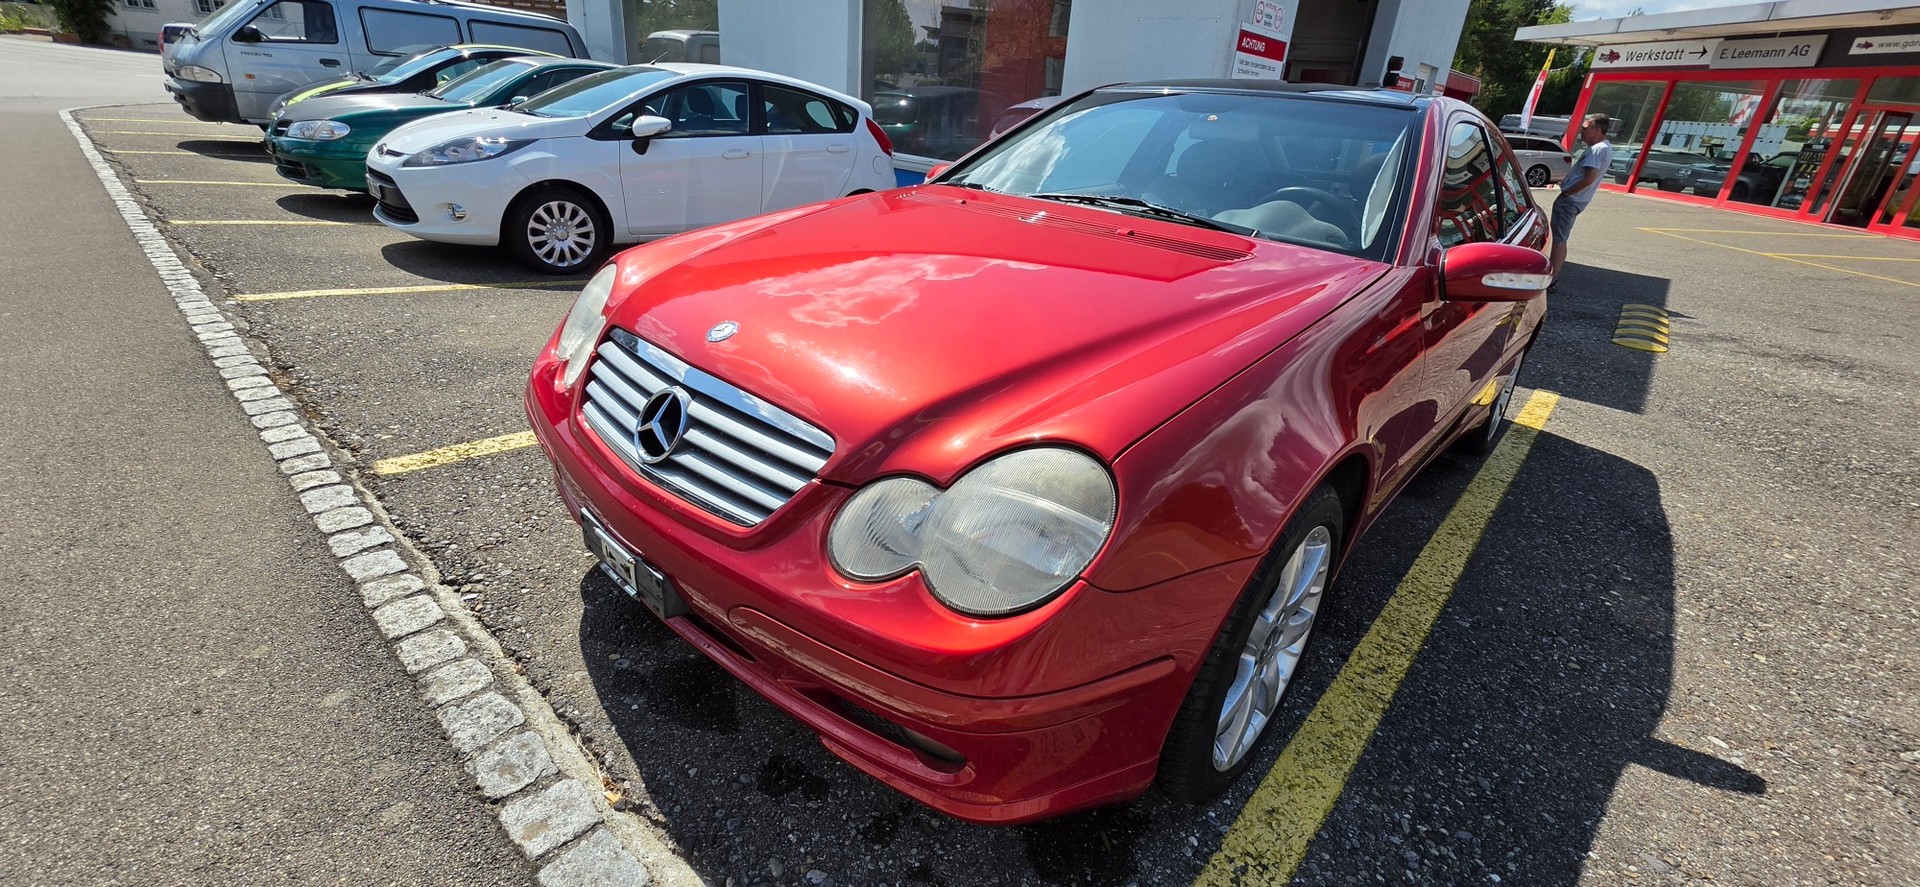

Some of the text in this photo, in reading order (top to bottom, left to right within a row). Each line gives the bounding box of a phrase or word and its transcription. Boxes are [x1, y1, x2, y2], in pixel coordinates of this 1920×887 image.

[1241, 37, 1265, 52] ACHTUNG
[1719, 44, 1811, 59] E. Leemann AG
[1878, 41, 1920, 49] www.gar
[1625, 48, 1684, 62] Werkstatt
